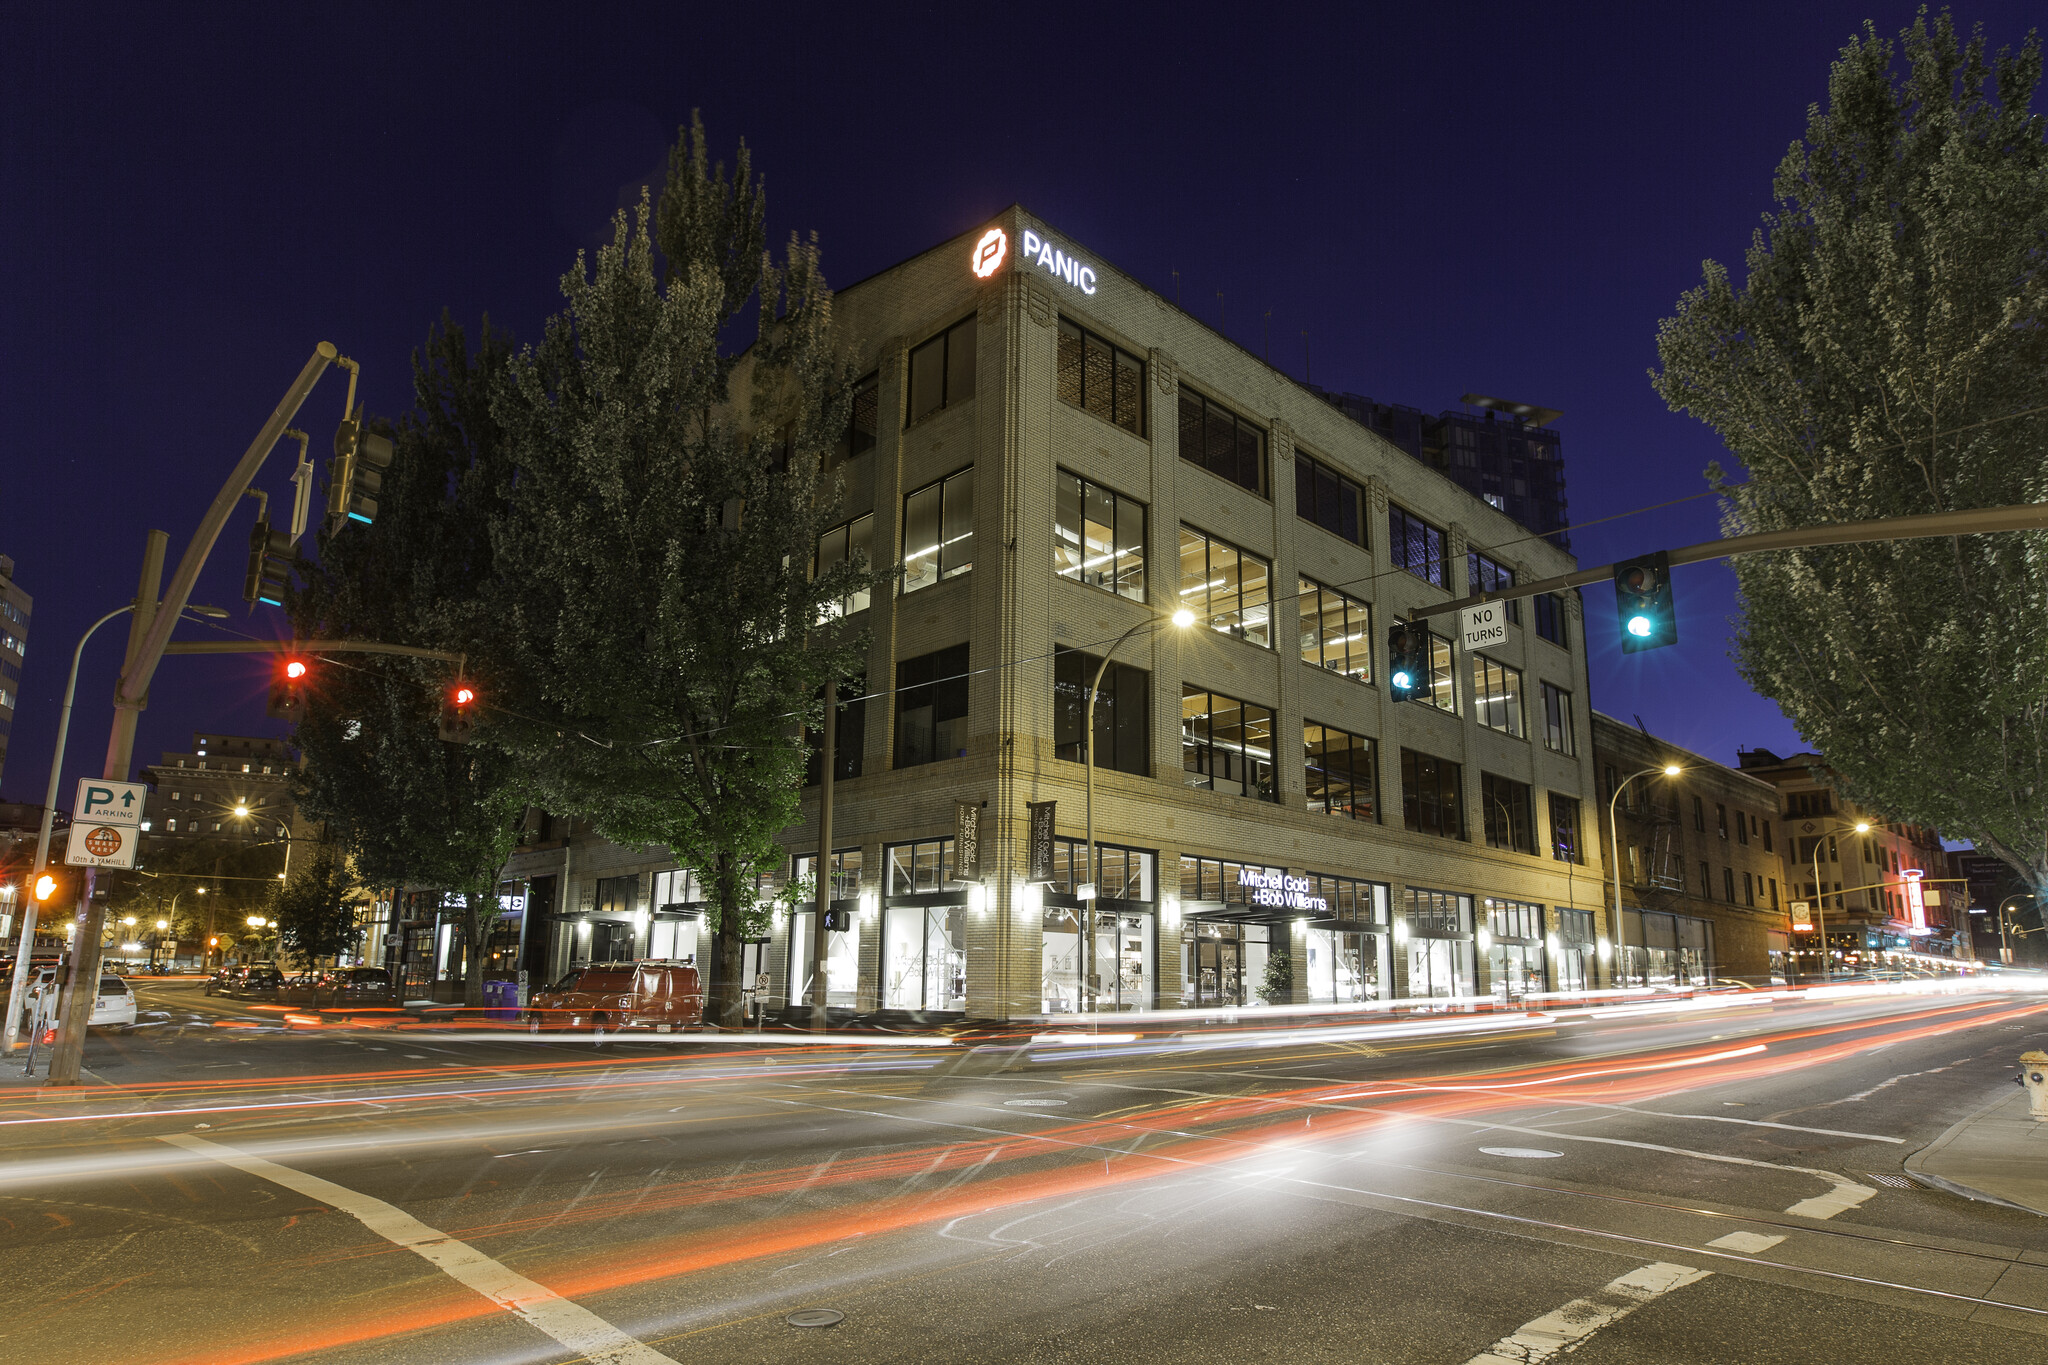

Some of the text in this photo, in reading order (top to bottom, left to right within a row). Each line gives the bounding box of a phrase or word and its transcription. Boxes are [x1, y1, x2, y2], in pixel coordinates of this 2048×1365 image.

[1024, 230, 1096, 295] PANIC
[1473, 609, 1493, 625] NO
[1465, 626, 1503, 643] TURNS
[88, 839, 120, 847] SMART
[969, 841, 977, 863] Gold
[97, 858, 126, 866] YAMHILL
[1240, 869, 1309, 893] Mitchell Gold
[1252, 888, 1327, 911] +Bob Williams
